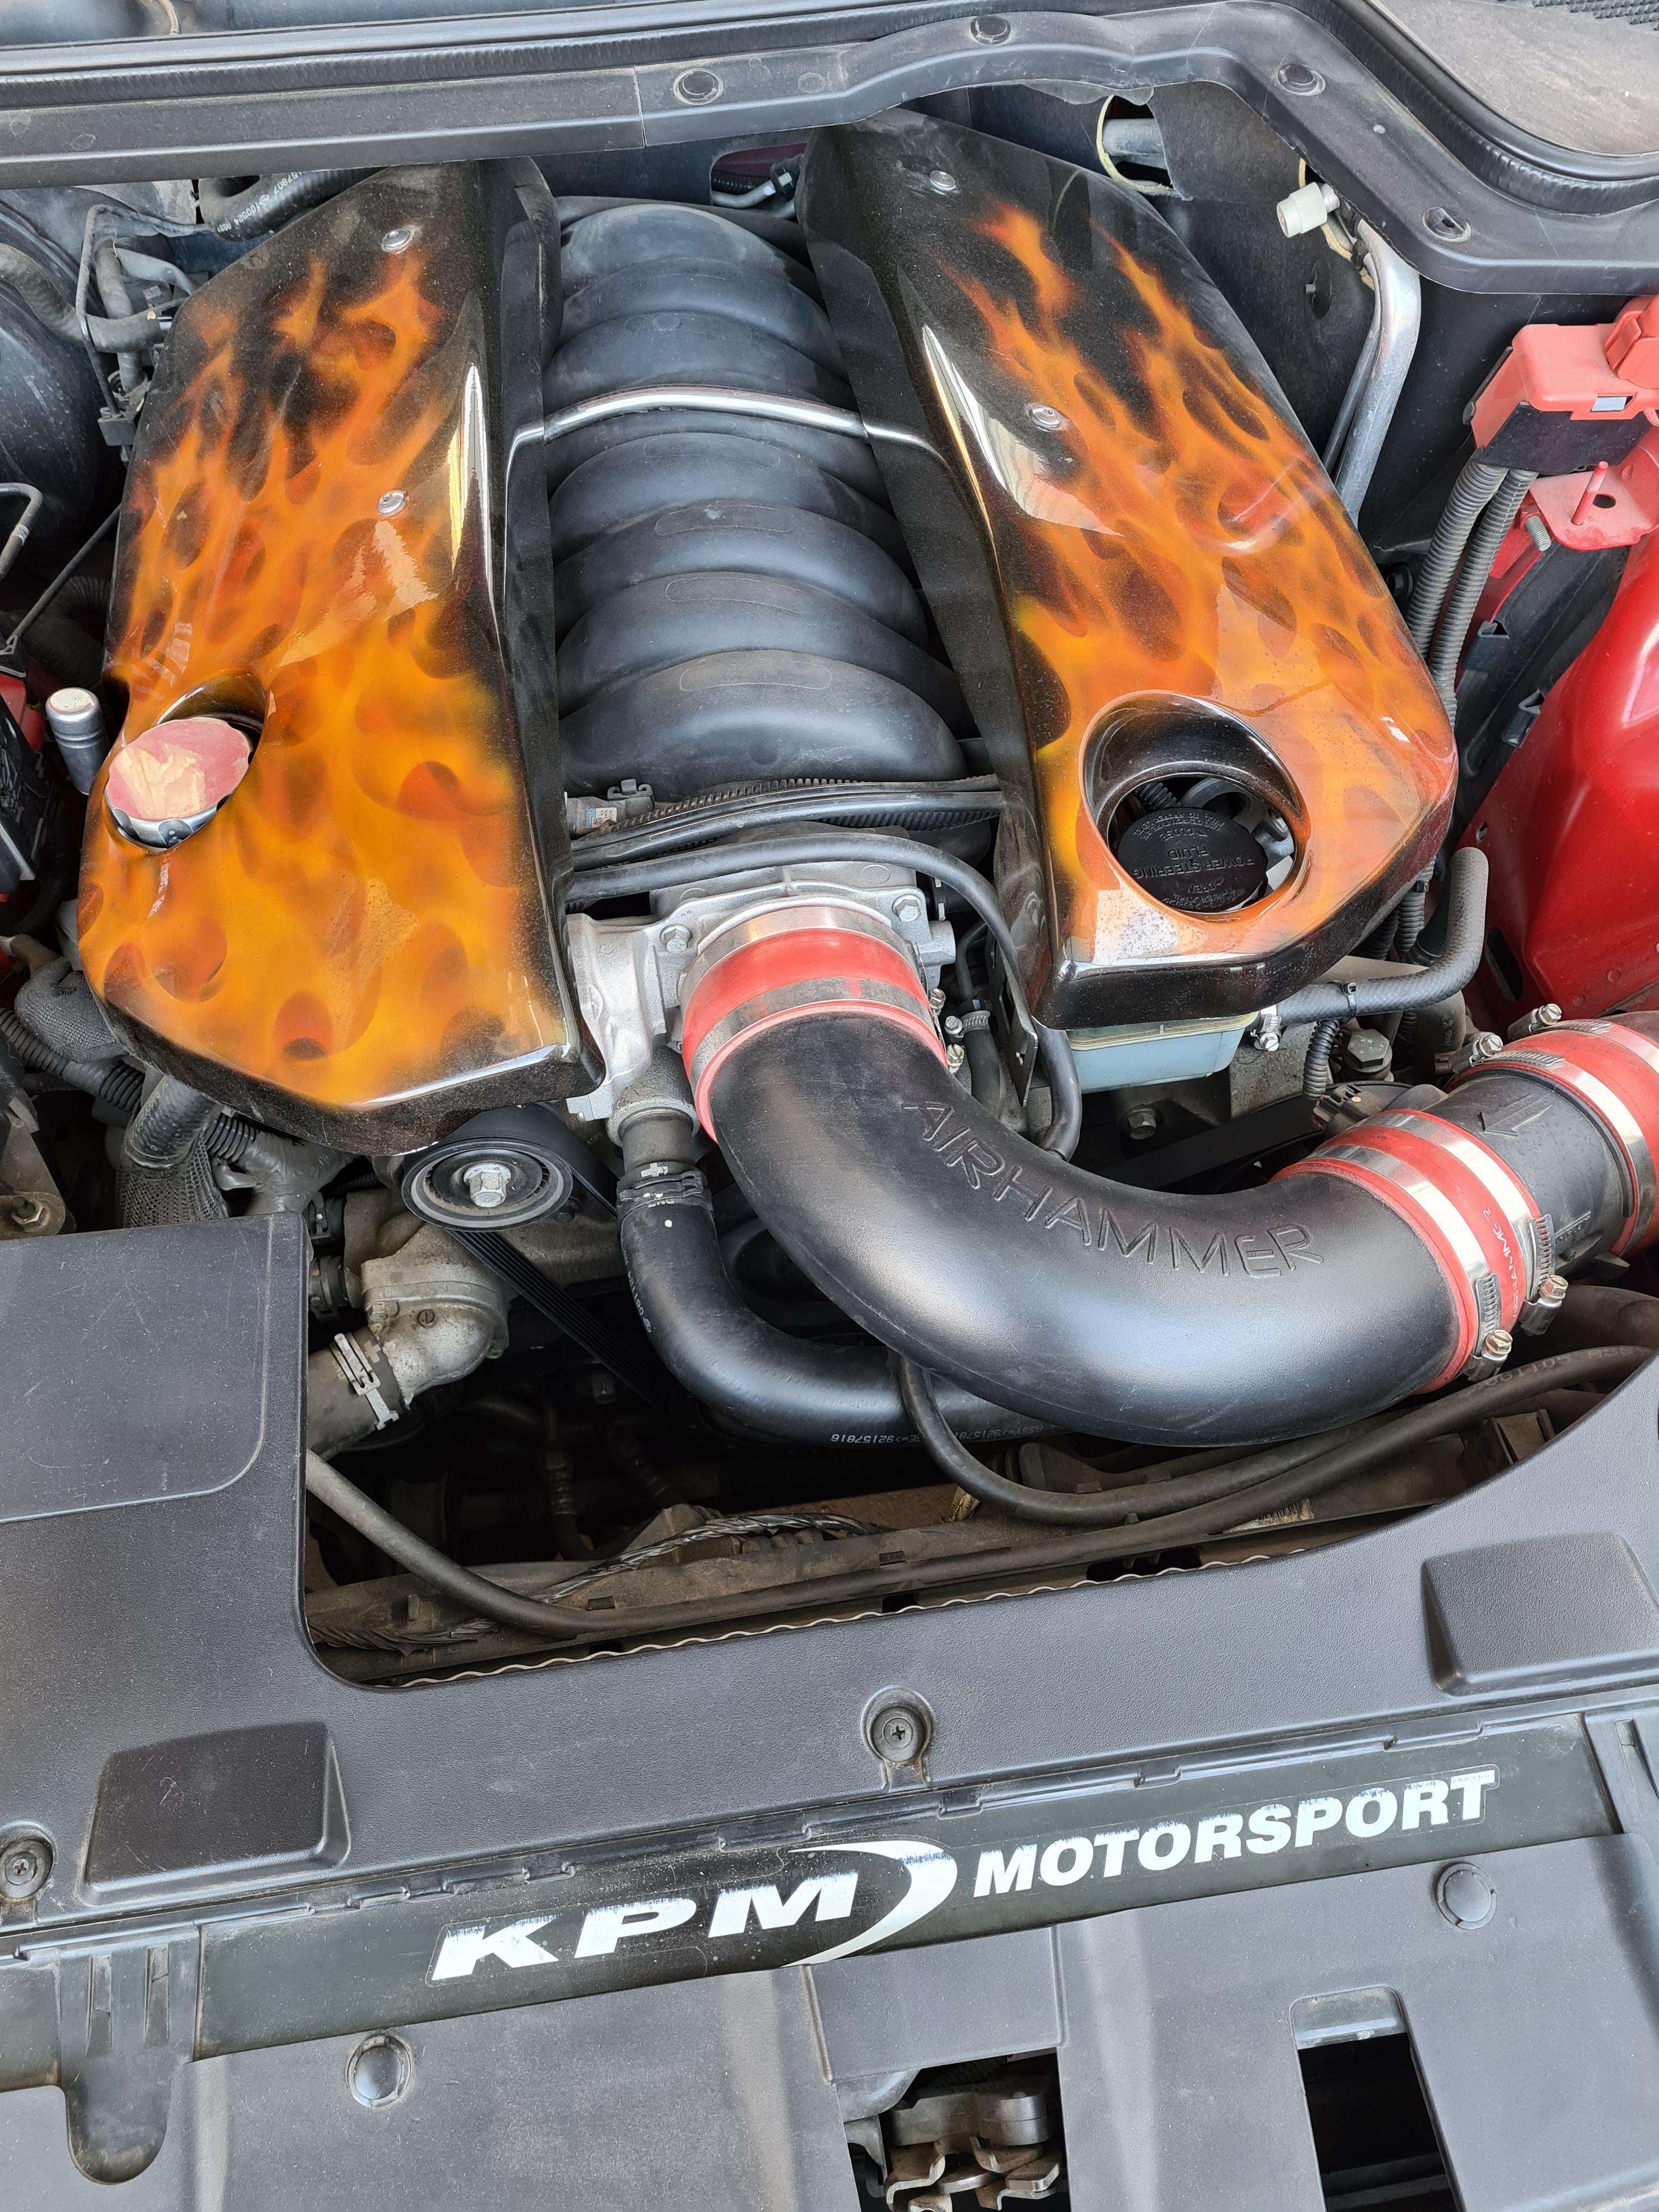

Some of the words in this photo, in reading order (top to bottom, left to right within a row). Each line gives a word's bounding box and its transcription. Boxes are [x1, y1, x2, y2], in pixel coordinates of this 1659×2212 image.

[1159, 827, 1194, 842] CLOSE
[1167, 845, 1209, 860] FLUID
[1133, 860, 1203, 878] STEERING
[1206, 856, 1255, 871] POWER
[1186, 882, 1216, 894] OPEN
[902, 1101, 1324, 1278] AIRHAMMER
[430, 1871, 859, 1983] KPM
[973, 1768, 1497, 1897] MOTORSPORT
